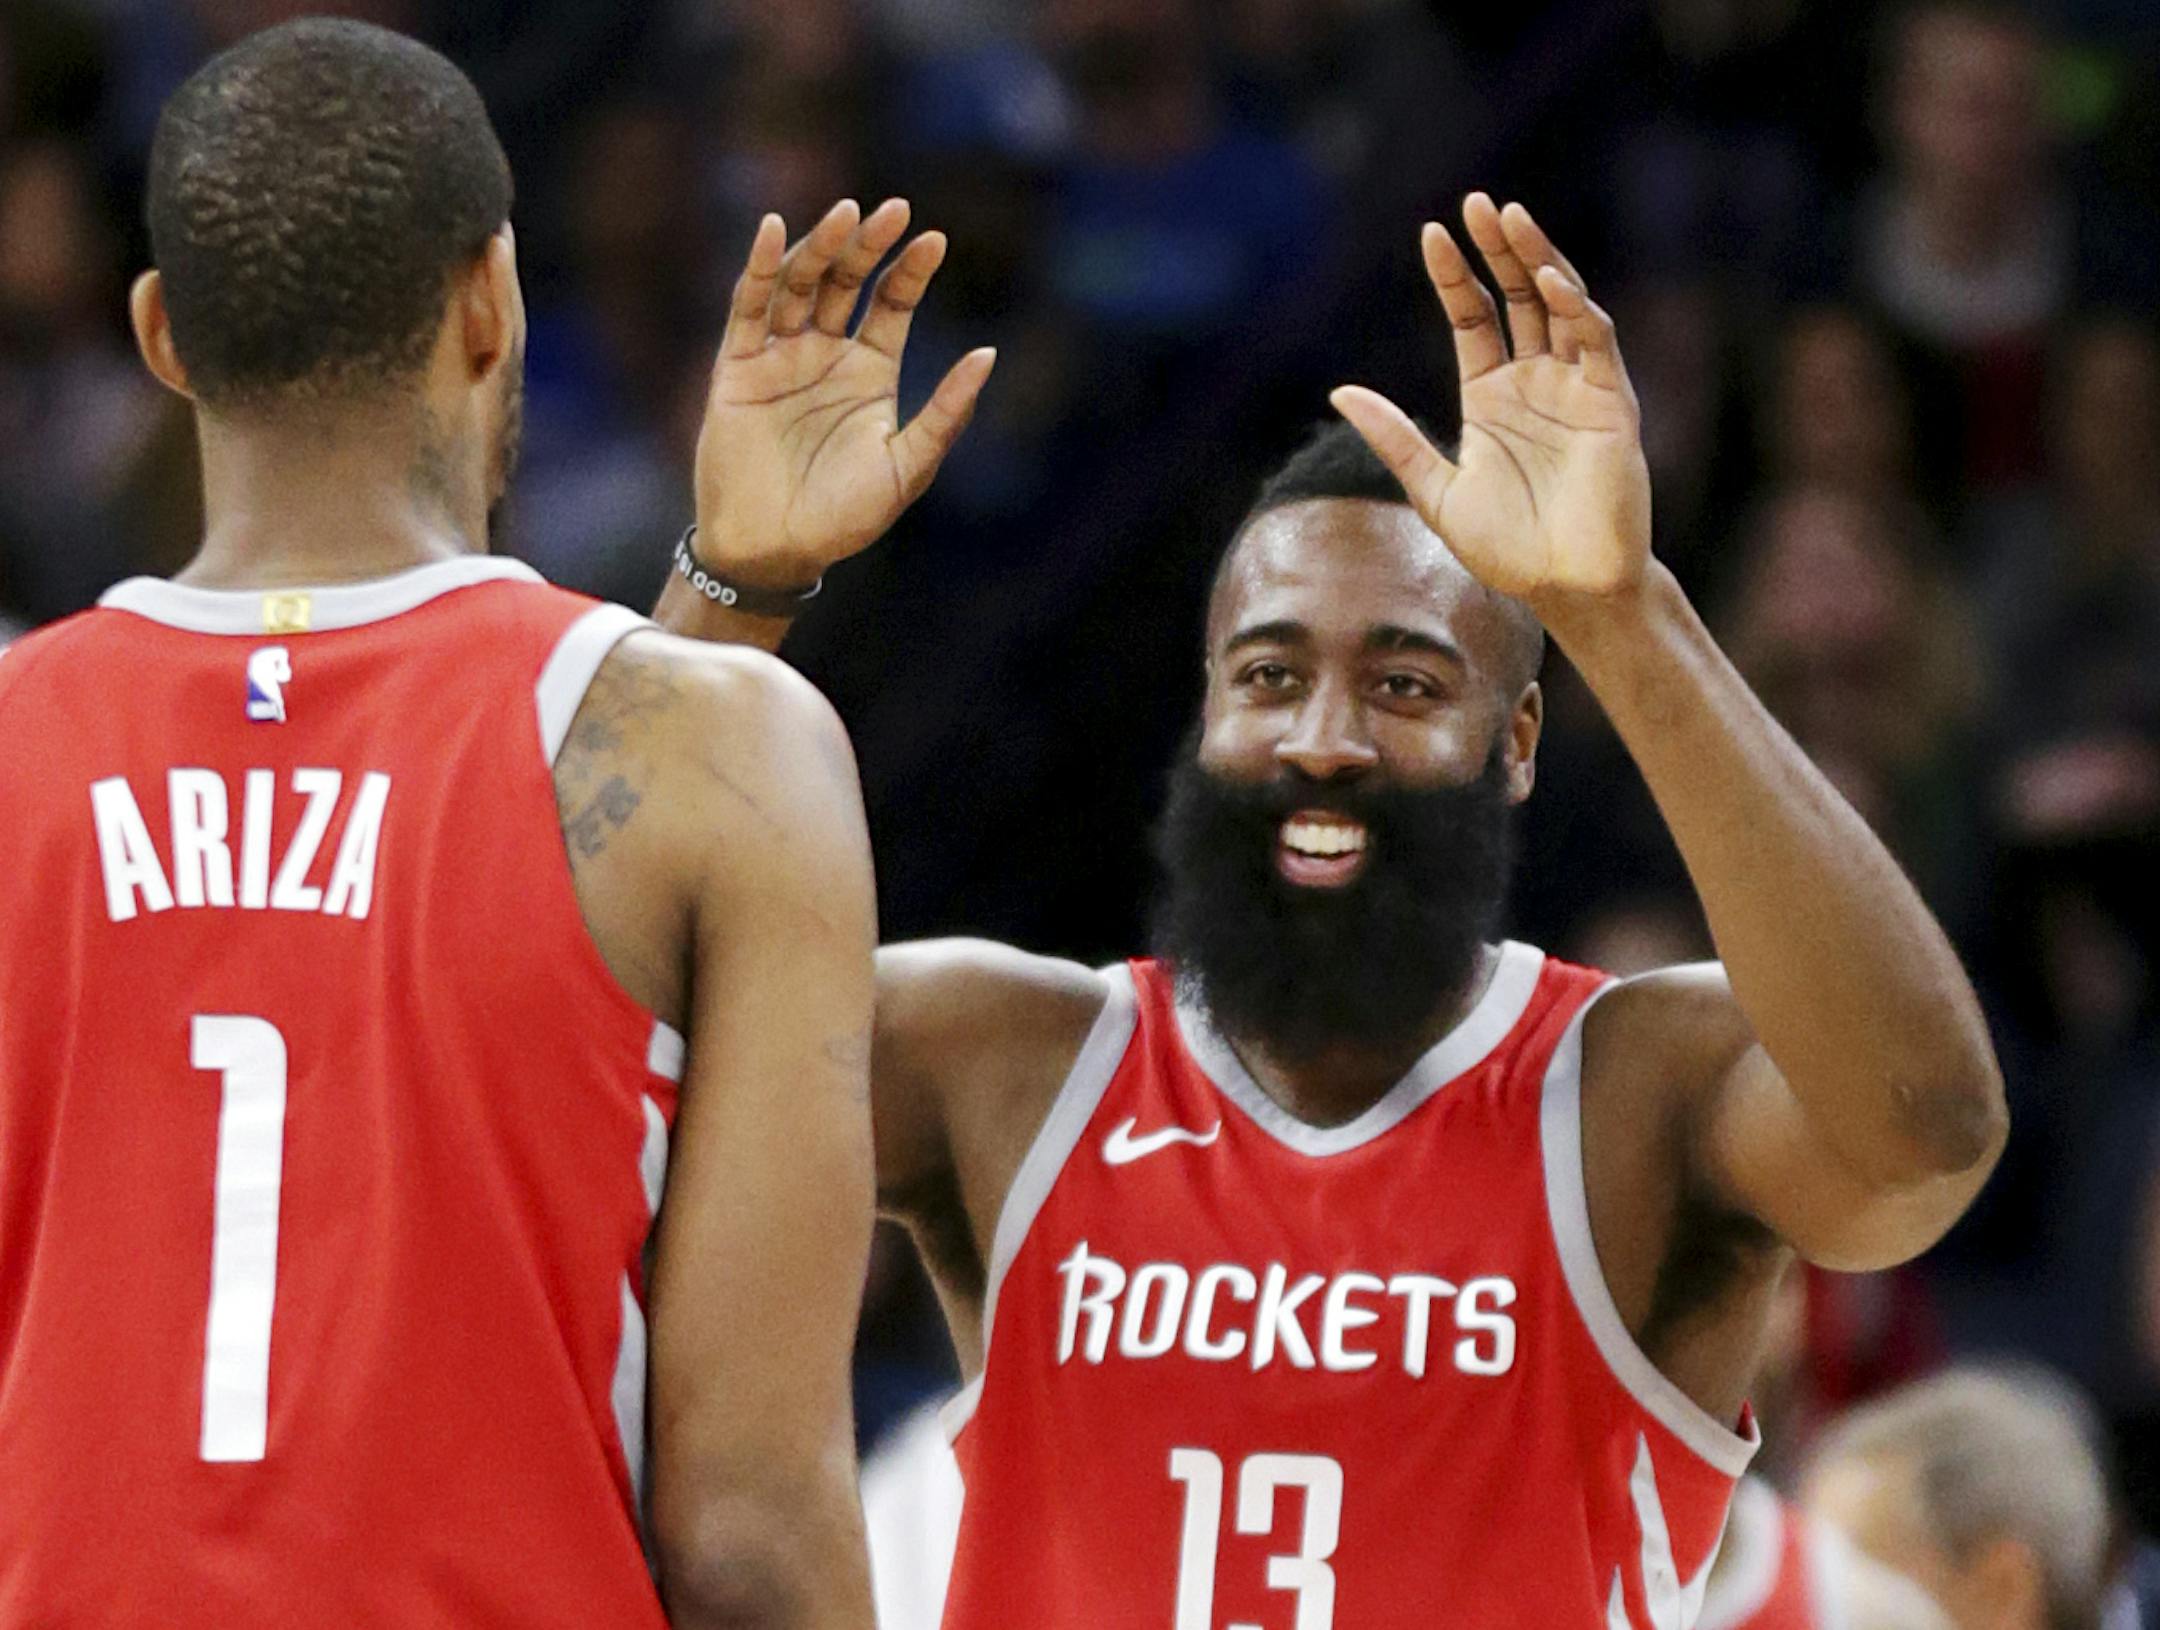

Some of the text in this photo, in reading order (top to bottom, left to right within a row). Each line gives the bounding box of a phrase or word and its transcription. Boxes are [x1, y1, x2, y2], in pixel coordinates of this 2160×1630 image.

[91, 767, 391, 922] ARIZA
[190, 1014, 287, 1462] 1
[1057, 1239, 1517, 1379] ROCKETS
[1169, 1447, 1344, 1630] 13
